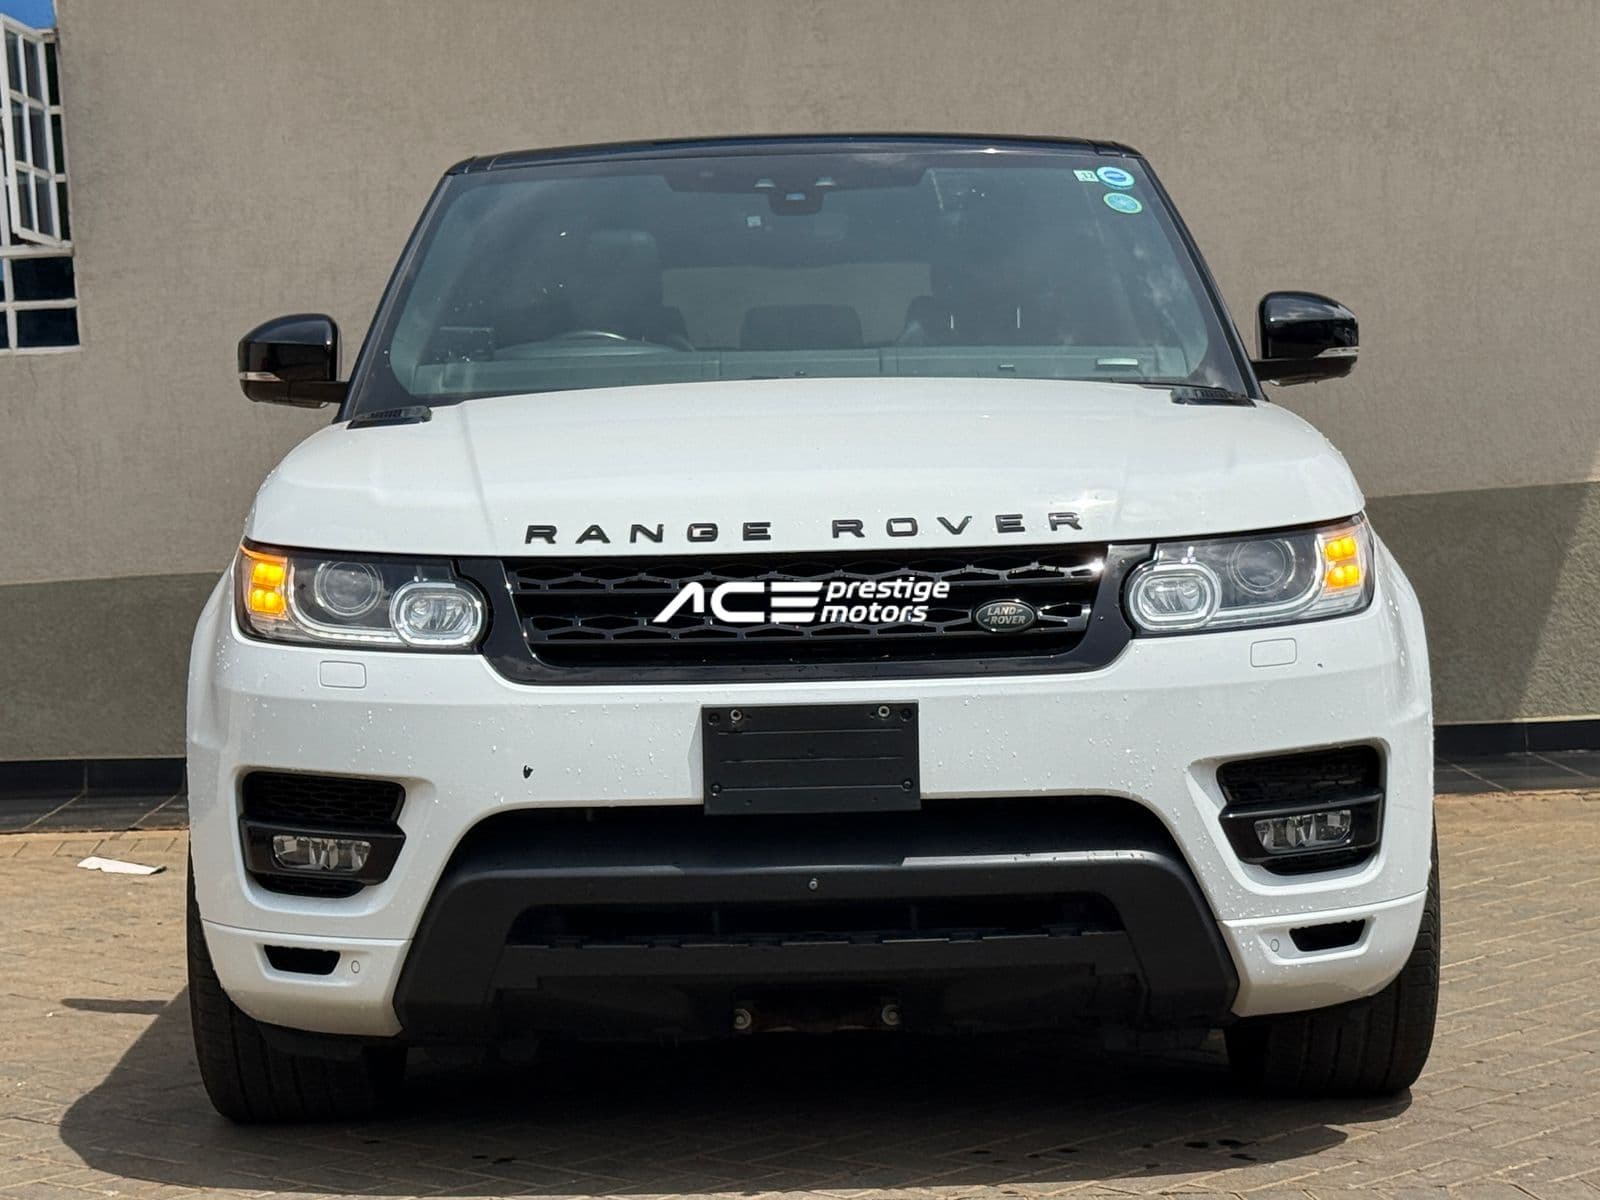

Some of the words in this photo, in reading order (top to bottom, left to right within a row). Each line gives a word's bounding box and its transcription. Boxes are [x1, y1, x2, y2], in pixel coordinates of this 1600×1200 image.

[525, 521, 771, 543] RANGE
[832, 511, 1084, 538] ROVER
[988, 607, 1016, 615] LAND
[990, 615, 1025, 624] ROVER
